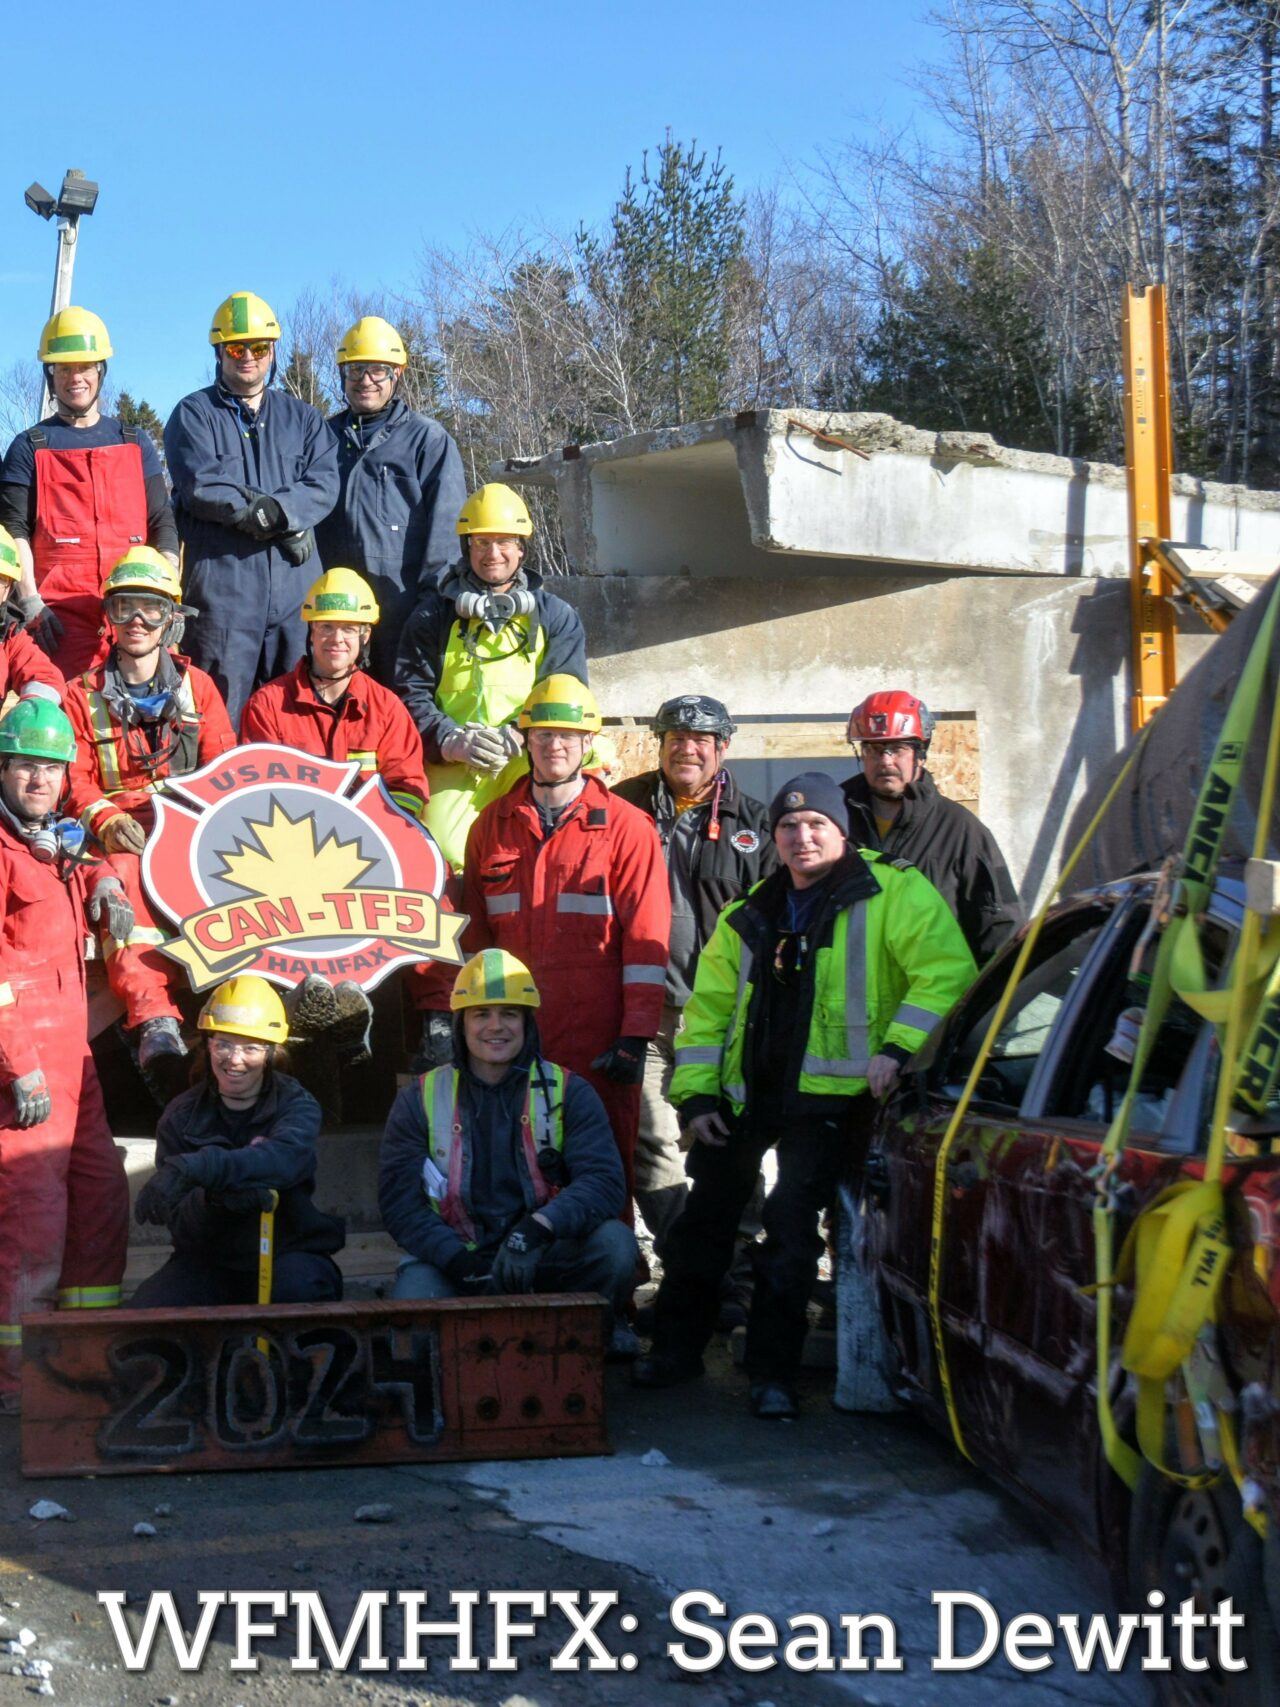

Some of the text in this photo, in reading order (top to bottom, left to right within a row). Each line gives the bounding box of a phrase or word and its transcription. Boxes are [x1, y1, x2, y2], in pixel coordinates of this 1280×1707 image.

[209, 763, 321, 792] USAR
[194, 893, 426, 952] CAN-TF5
[267, 948, 392, 975] HALIFAX
[99, 1326, 446, 1457] 2024
